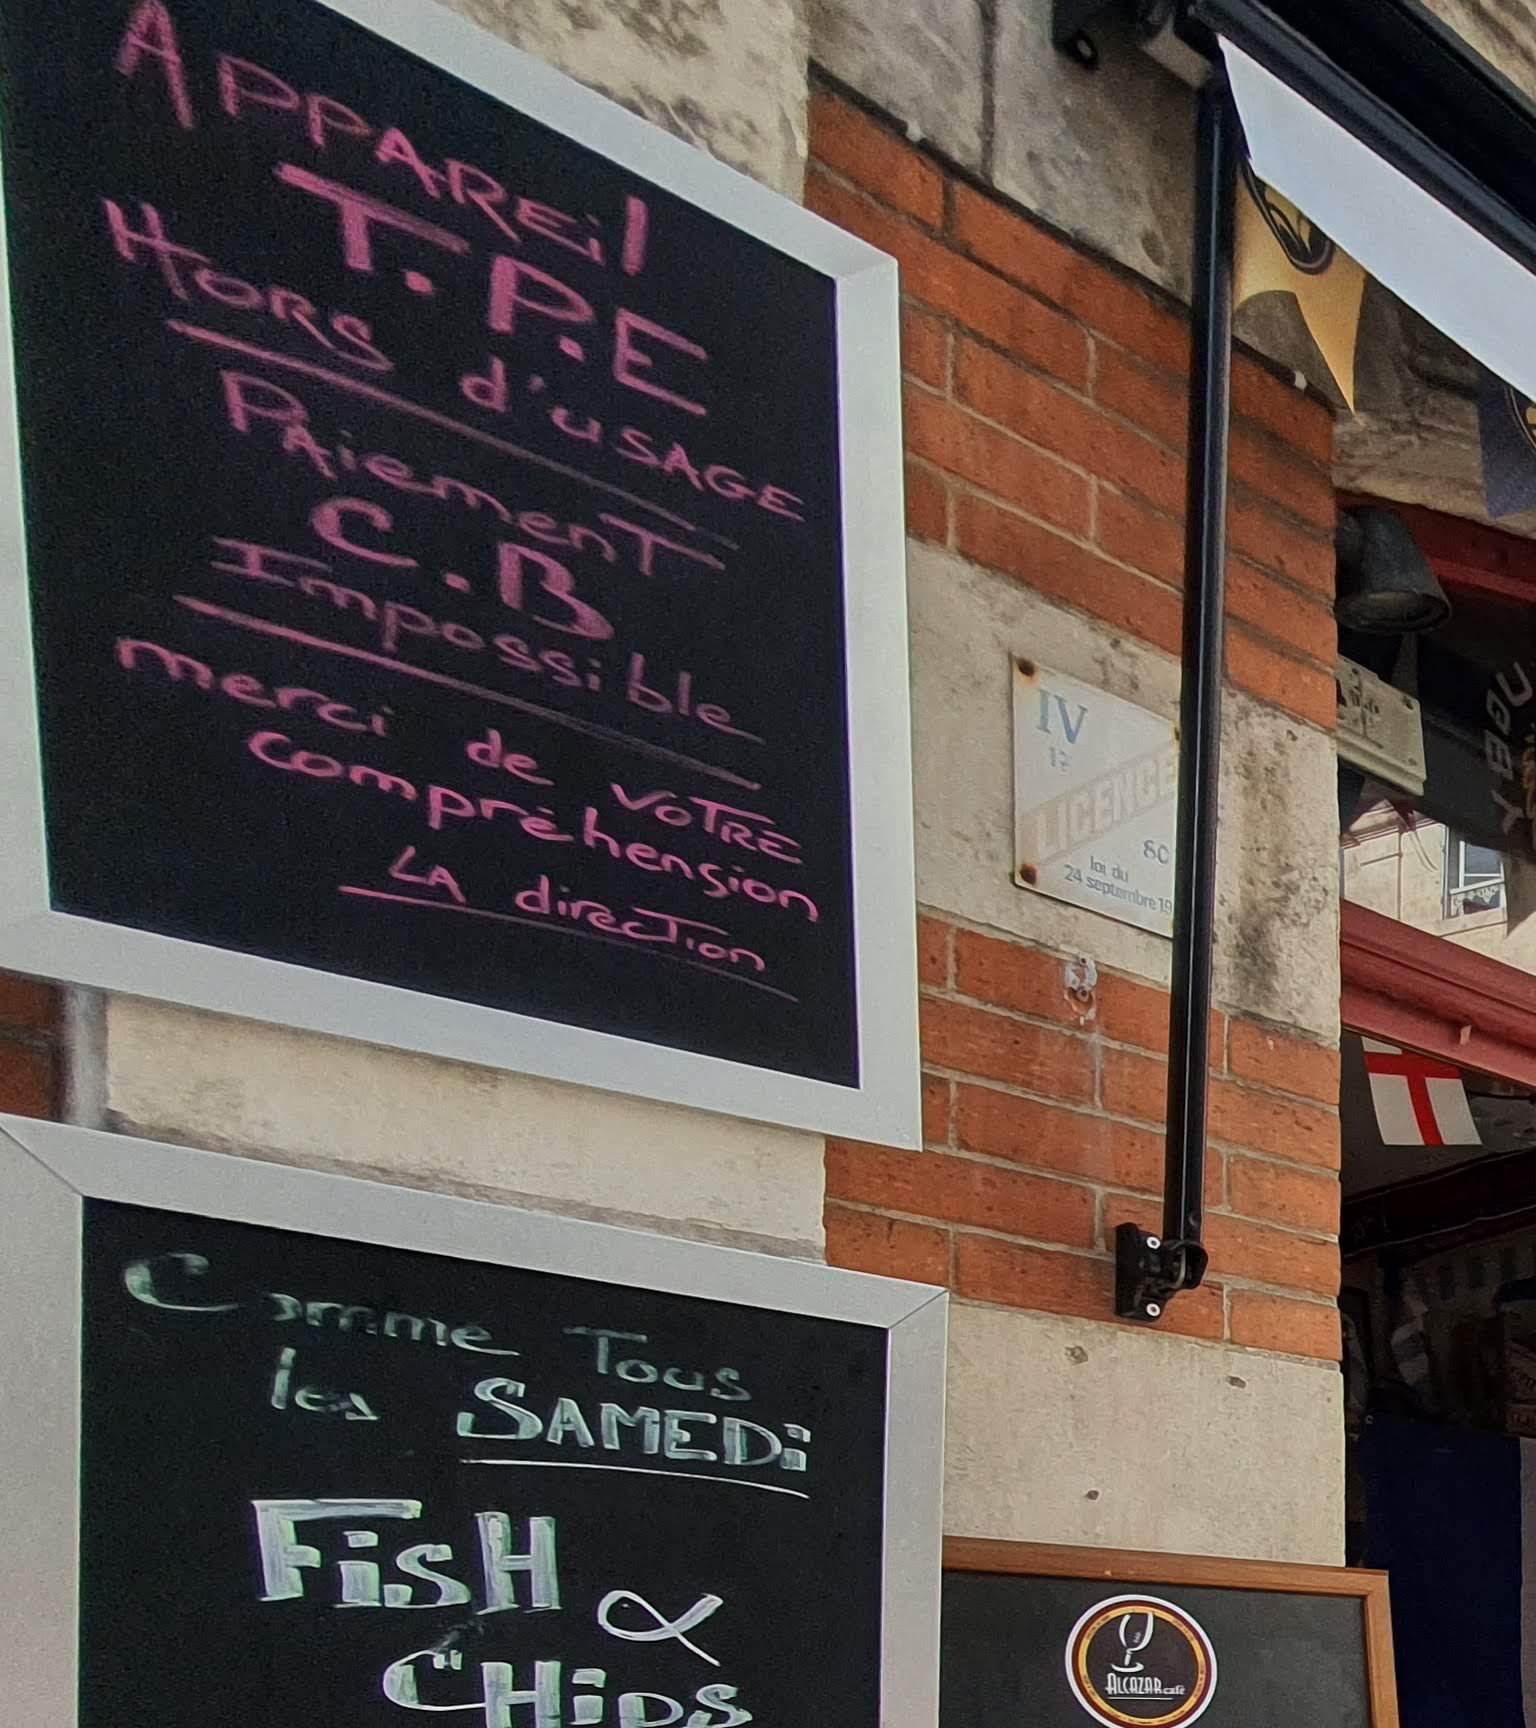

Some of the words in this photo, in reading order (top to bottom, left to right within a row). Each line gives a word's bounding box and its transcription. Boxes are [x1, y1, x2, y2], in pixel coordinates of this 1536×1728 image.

[103, 199, 394, 375] HORS
[209, 536, 765, 744] Impossible
[115, 634, 395, 739] merci
[465, 730, 553, 787] de
[1035, 687, 1088, 745] IV
[388, 846, 467, 904] LA
[515, 875, 766, 974] direction
[1064, 864, 1082, 884] 24
[1086, 876, 1156, 910] septembre
[1112, 864, 1128, 883] du
